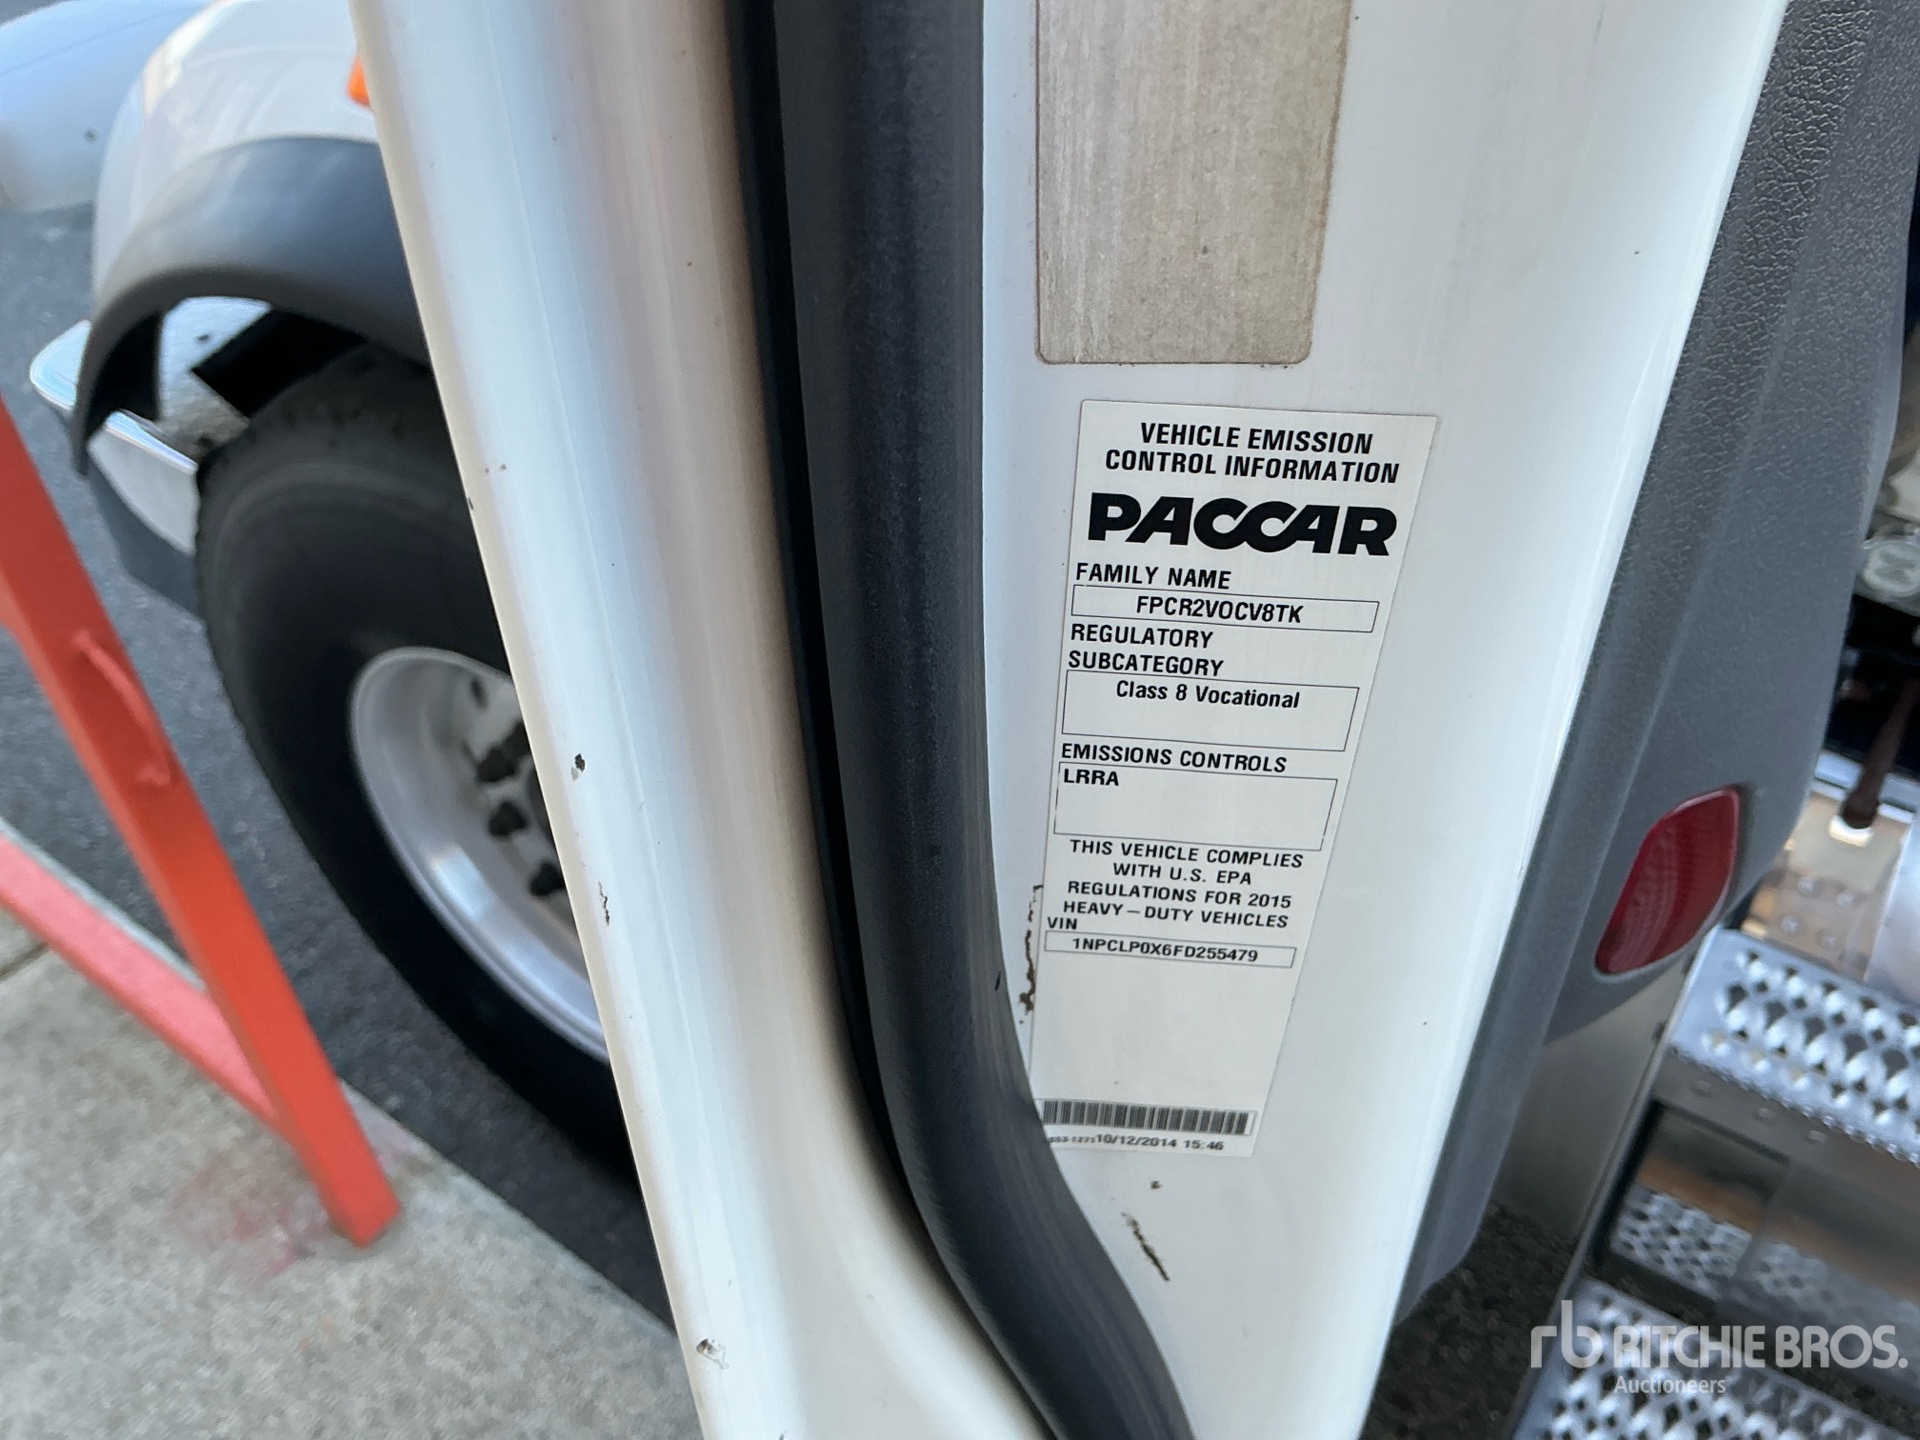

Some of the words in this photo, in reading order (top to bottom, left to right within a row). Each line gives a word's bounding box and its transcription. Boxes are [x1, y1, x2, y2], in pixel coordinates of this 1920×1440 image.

[1141, 422, 1240, 448] VEHICLE
[1248, 429, 1373, 454] EMISSION
[1105, 450, 1216, 475] CONTROL
[1225, 456, 1399, 483] INFORMATION
[1088, 492, 1397, 556] PACCAR
[1076, 562, 1158, 584] FAMILY
[1168, 568, 1232, 589] NAME
[1071, 623, 1213, 649] REGULATORY
[1068, 651, 1224, 676] SUBCATEGORY
[1116, 680, 1168, 700] Class
[1175, 683, 1187, 701] 8
[1196, 685, 1300, 708] Vocational
[1061, 743, 1172, 765] EMISSIONS
[1180, 751, 1287, 773] CONTROLS
[1064, 769, 1119, 787] LRRA
[1069, 839, 1112, 855] THIS
[1121, 843, 1198, 862] VEHICLE
[1206, 849, 1303, 868] COMPLIES
[1113, 863, 1162, 879] WITH
[1169, 868, 1207, 883] U.S.
[1217, 870, 1252, 885] EPA
[1068, 881, 1197, 903] REGULATIONS
[1205, 891, 1243, 905] FOR
[1248, 893, 1292, 909] 2015
[1047, 917, 1078, 930] VIN
[1200, 911, 1288, 929] VEHICLES
[1097, 1134, 1177, 1147] 10/12/2014
